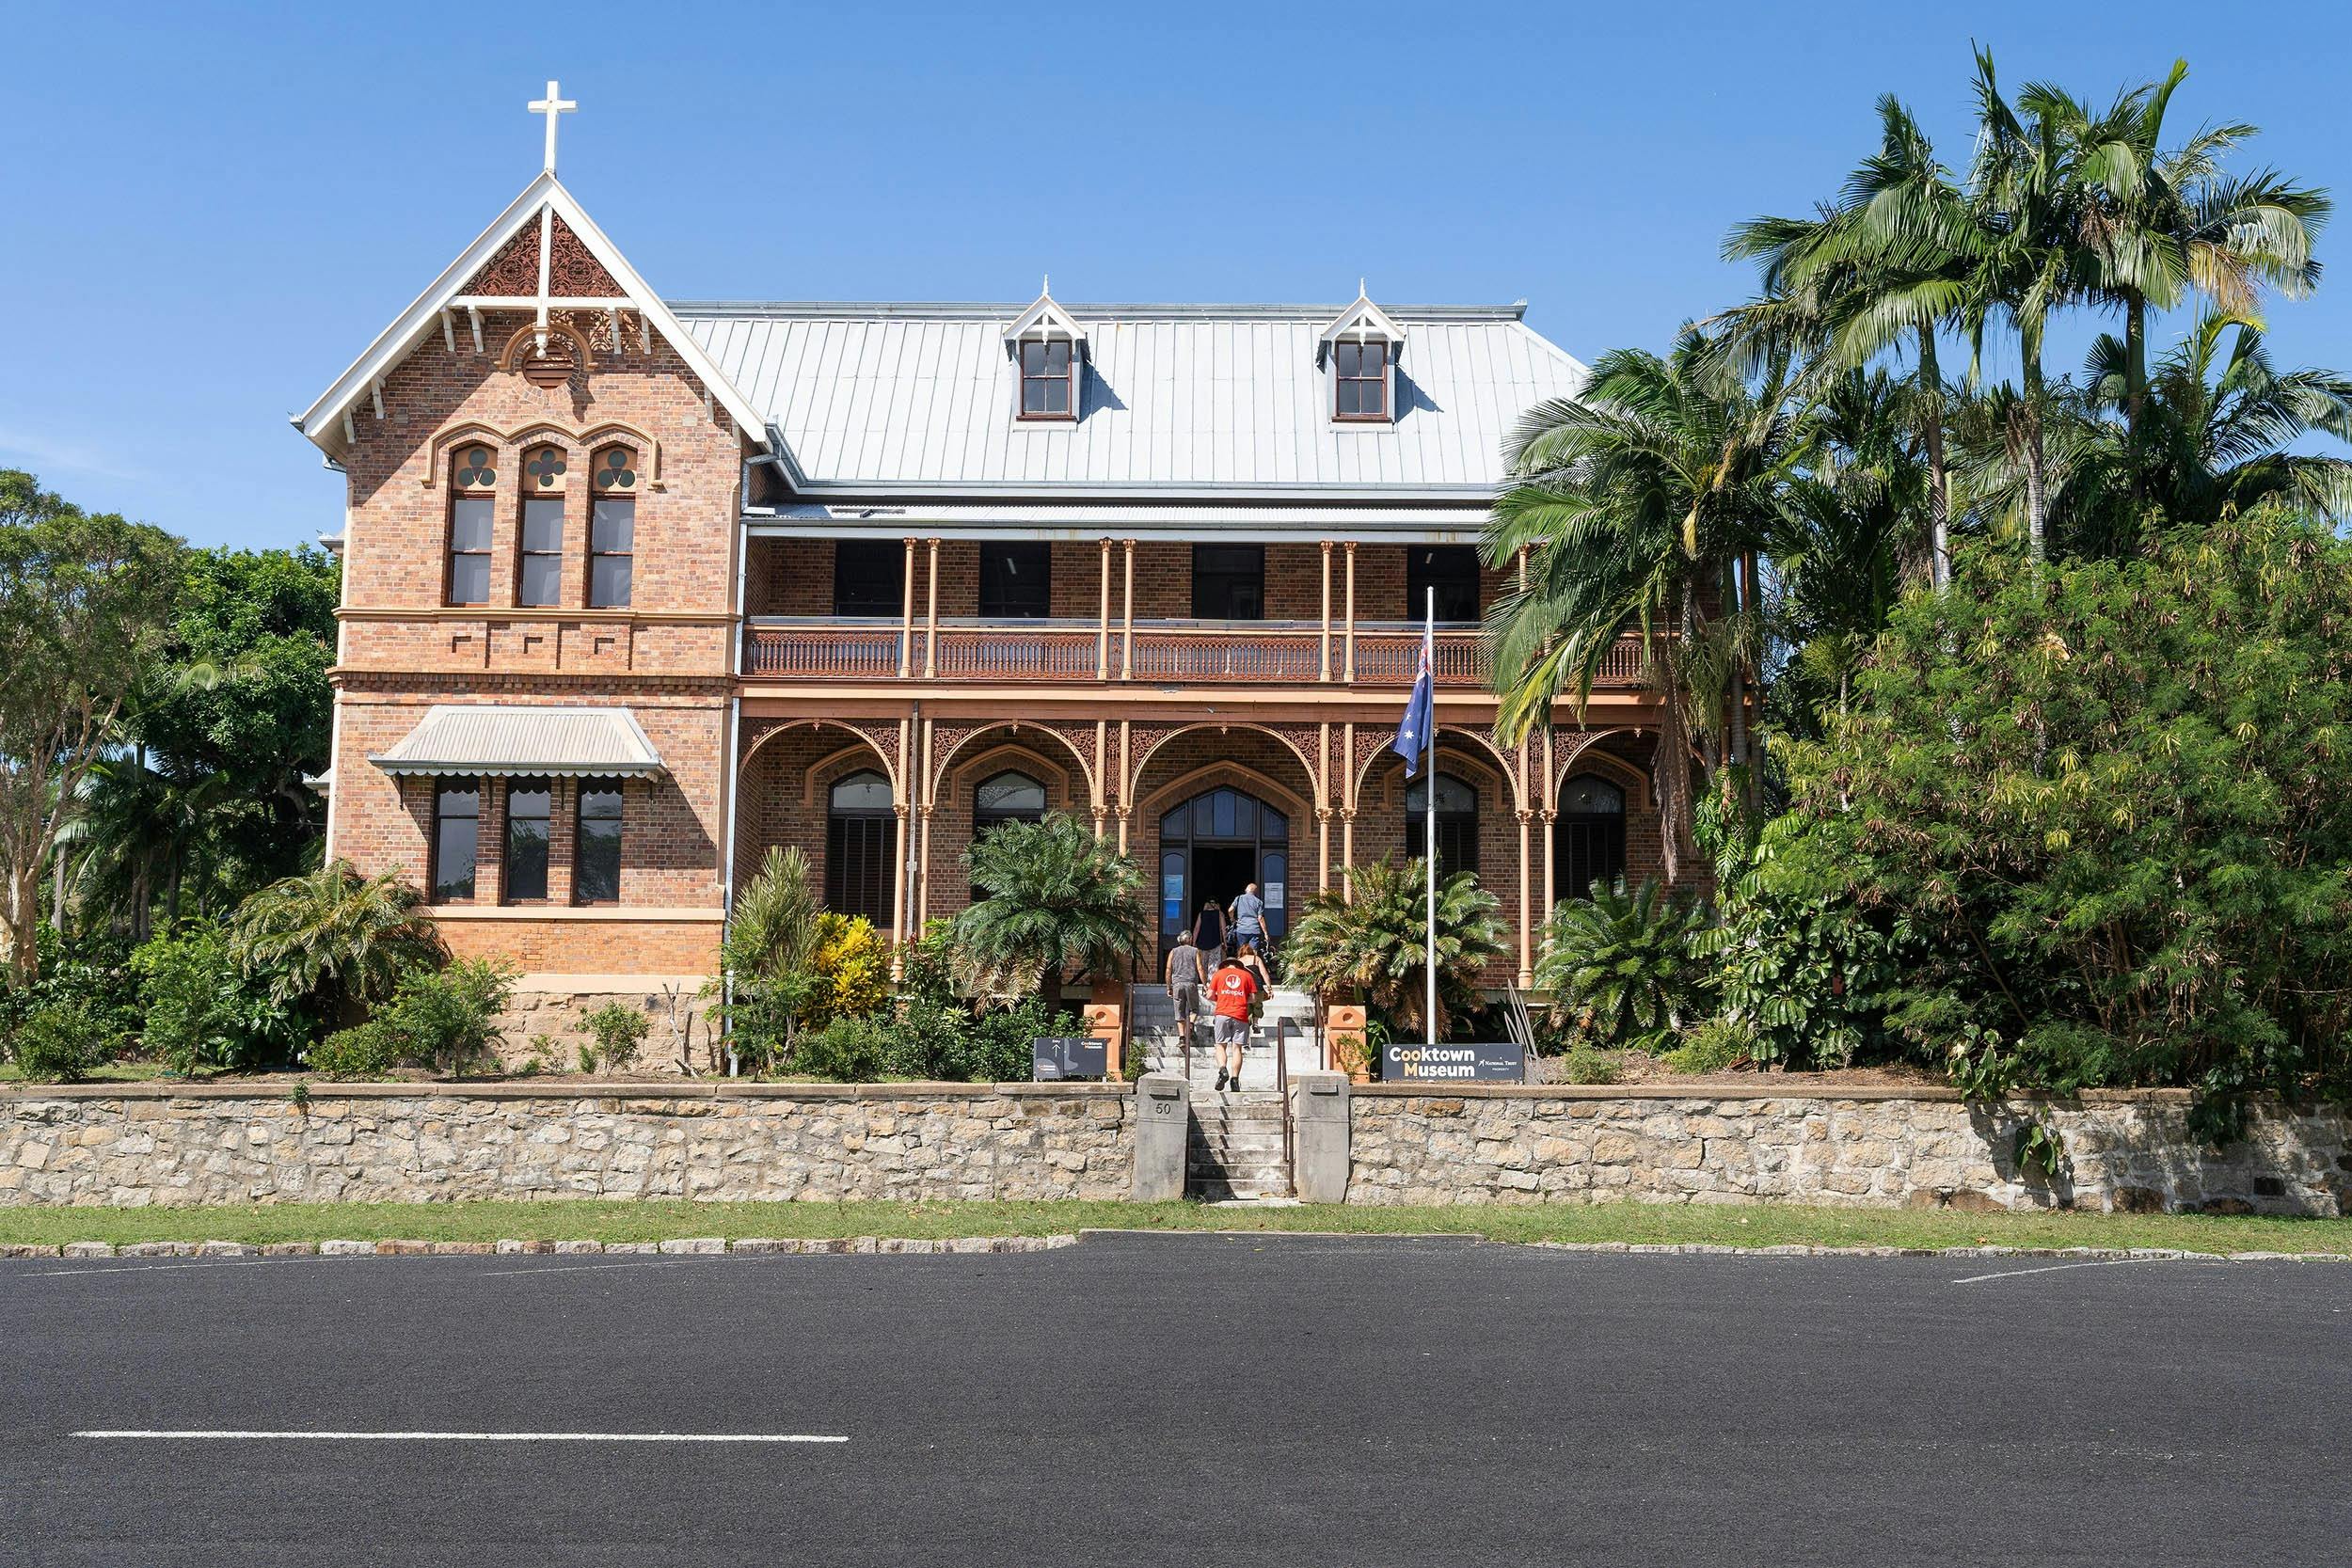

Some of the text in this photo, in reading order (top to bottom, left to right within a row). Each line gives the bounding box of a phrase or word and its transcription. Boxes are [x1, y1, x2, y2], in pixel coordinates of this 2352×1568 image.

[1390, 1047, 1475, 1062] Cooktown
[1404, 1063, 1475, 1077] Museum
[1155, 1103, 1171, 1115] 50
